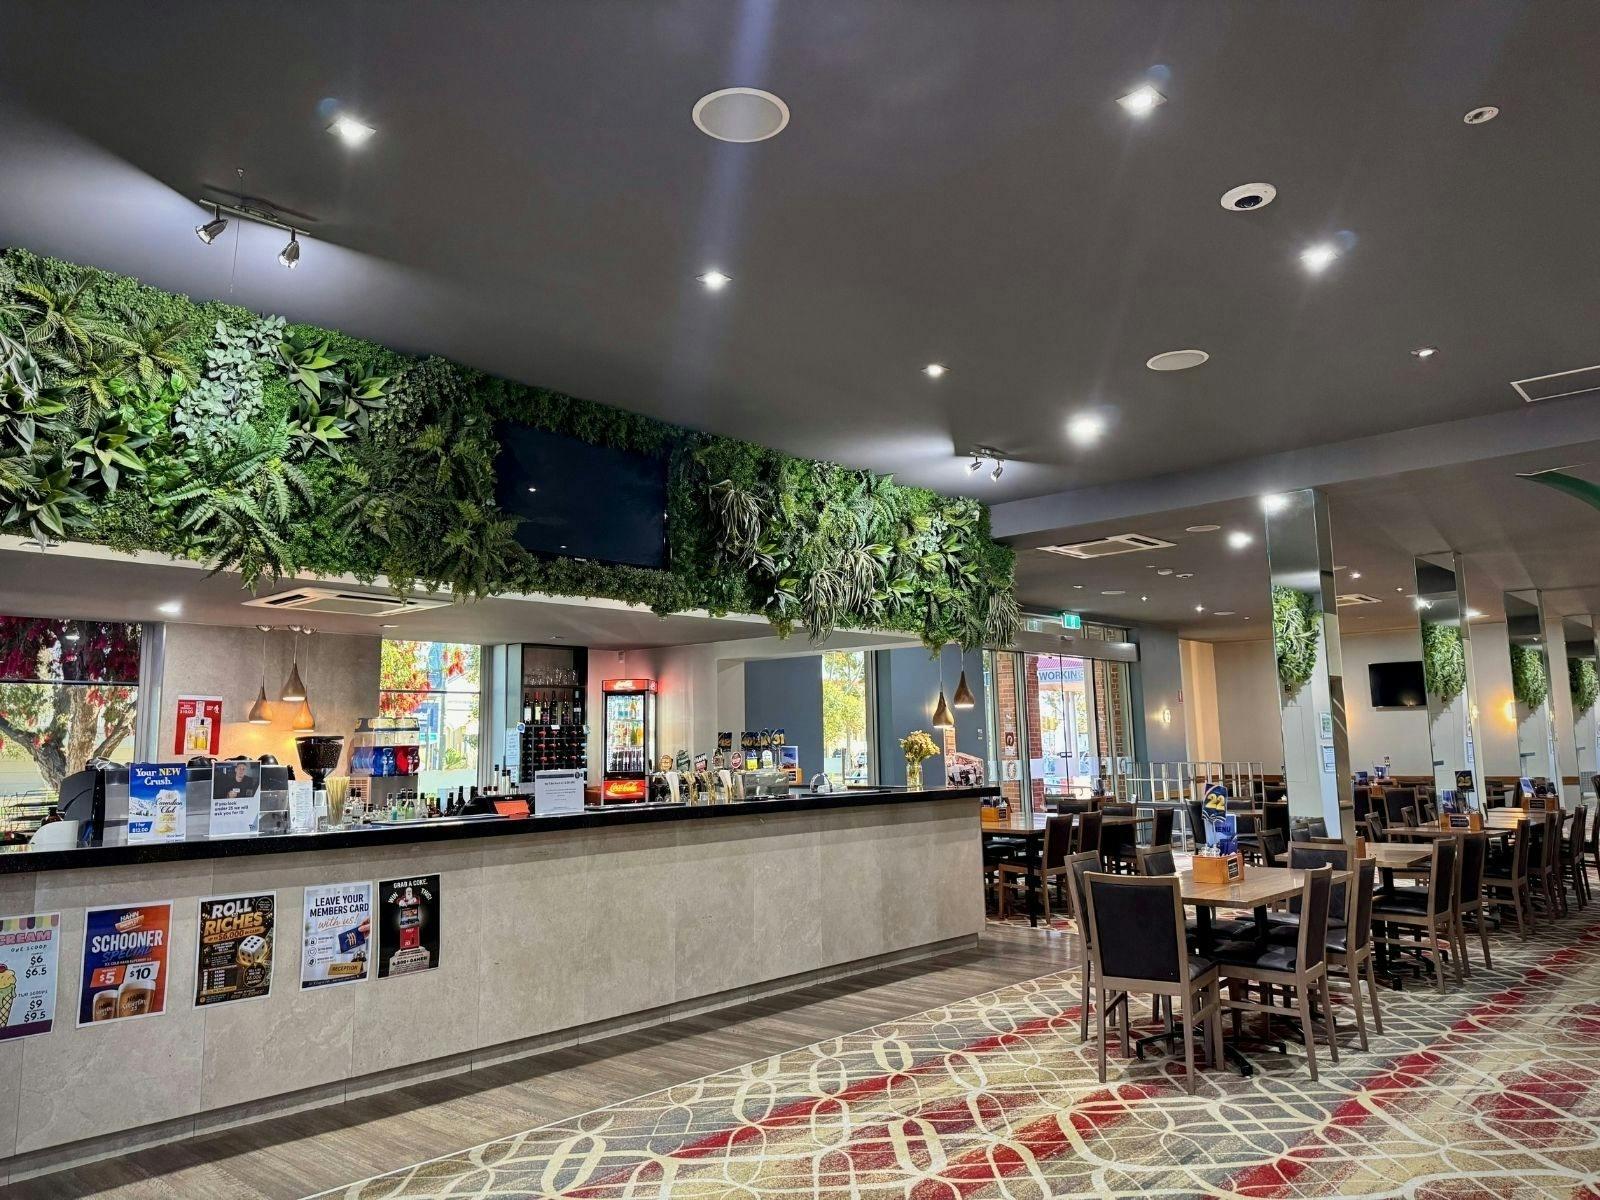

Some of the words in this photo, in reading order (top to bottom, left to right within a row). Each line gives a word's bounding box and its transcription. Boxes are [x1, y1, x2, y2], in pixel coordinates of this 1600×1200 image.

[135, 768, 157, 777] Your
[159, 767, 181, 776] NEW
[144, 777, 173, 786] Crush.
[1457, 776, 1472, 787] 25
[1205, 793, 1225, 811] 22
[393, 881, 408, 889] GRAB
[315, 895, 341, 907] LEAVE
[342, 893, 364, 904] YOUR
[211, 899, 252, 919] ROLL
[309, 905, 348, 918] MEMBERS
[349, 903, 369, 913] CARD
[204, 911, 263, 937] RICHES
[317, 916, 340, 929] with
[91, 930, 163, 953] SCHOONER
[102, 945, 152, 962] SPECIAL
[30, 955, 44, 966] $6
[25, 966, 47, 979] $6.5
[99, 971, 116, 984] $5
[129, 967, 151, 980] $10
[29, 999, 43, 1011] $9
[24, 1010, 46, 1023] $9.5
